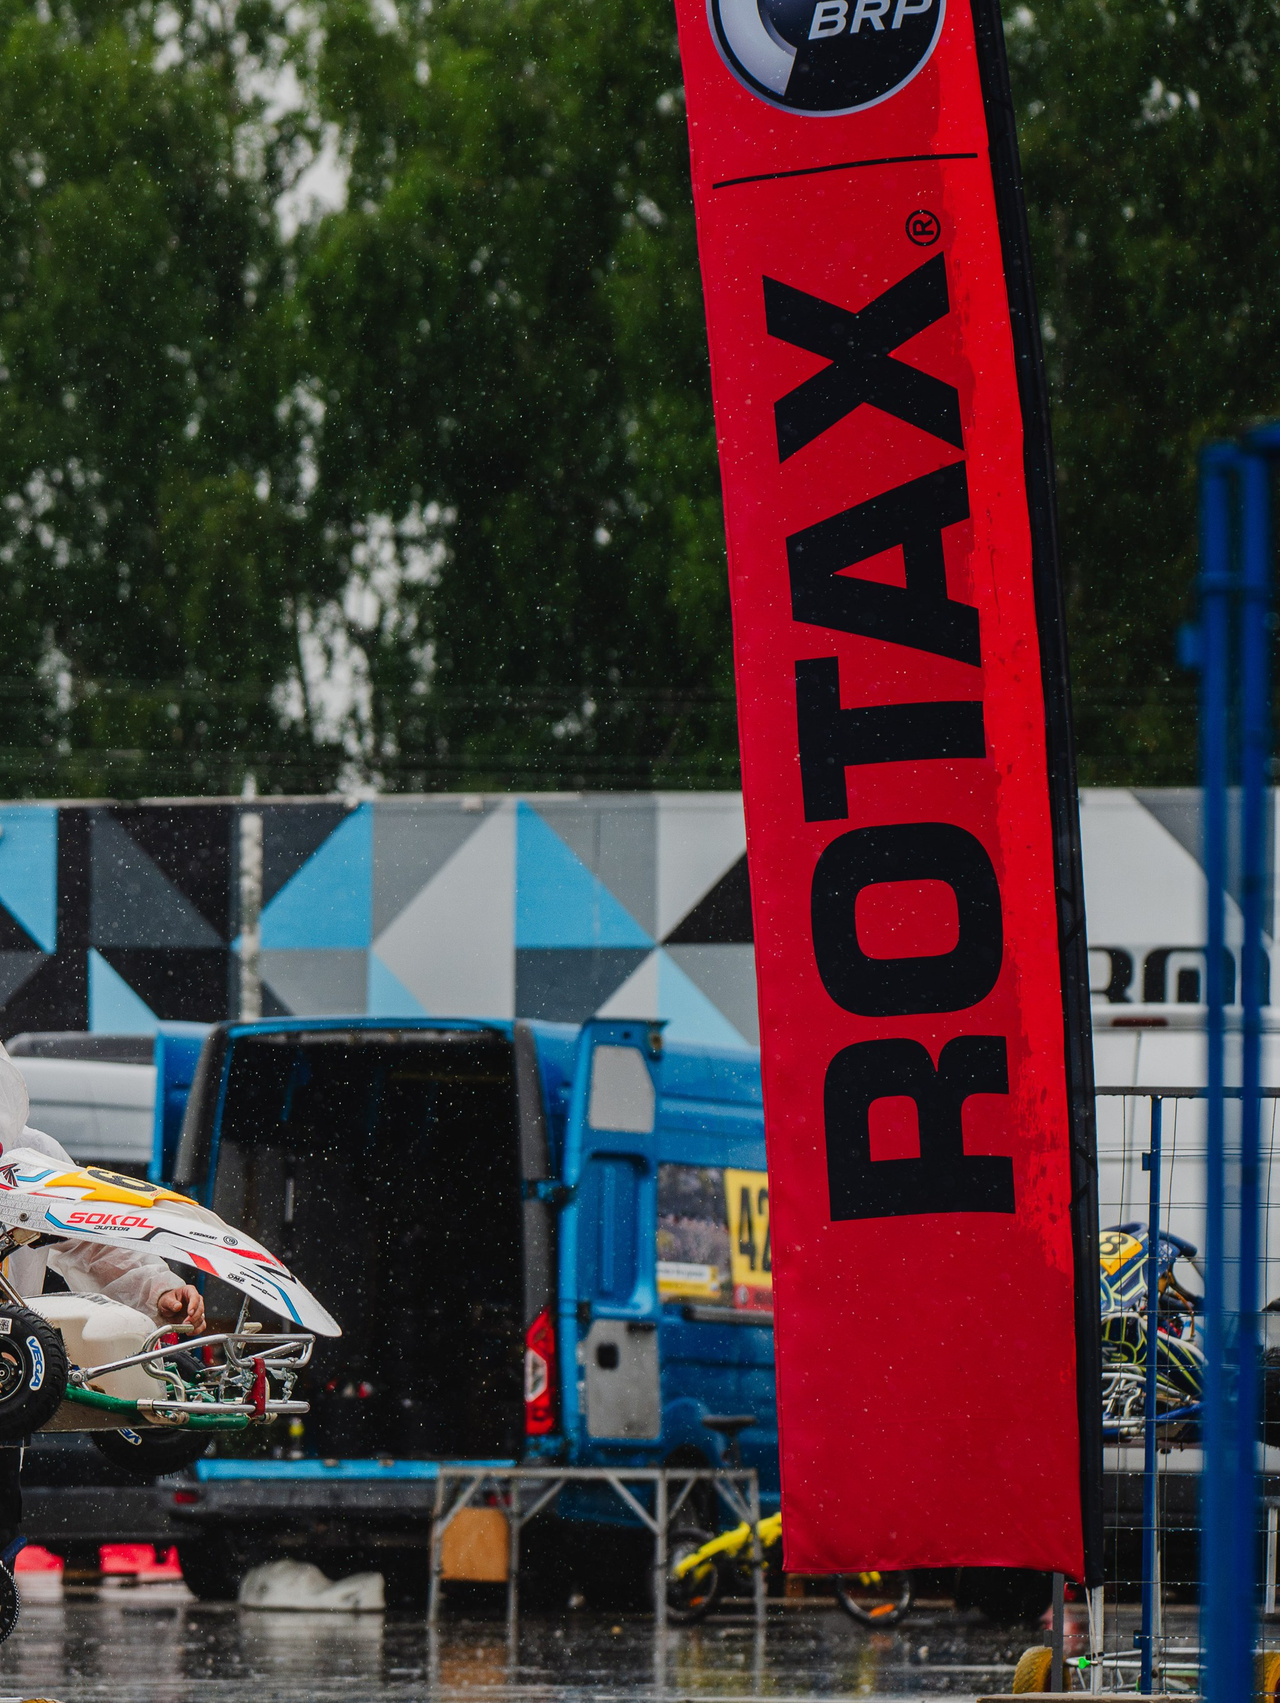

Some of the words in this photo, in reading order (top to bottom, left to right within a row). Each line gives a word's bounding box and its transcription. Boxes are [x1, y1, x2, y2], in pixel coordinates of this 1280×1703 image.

[808, 0, 933, 40] BRP
[762, 250, 1017, 1222] ROTAX
[66, 1212, 154, 1228] SOKOL
[29, 1337, 45, 1388] VEGA
[119, 1428, 140, 1444] VE
